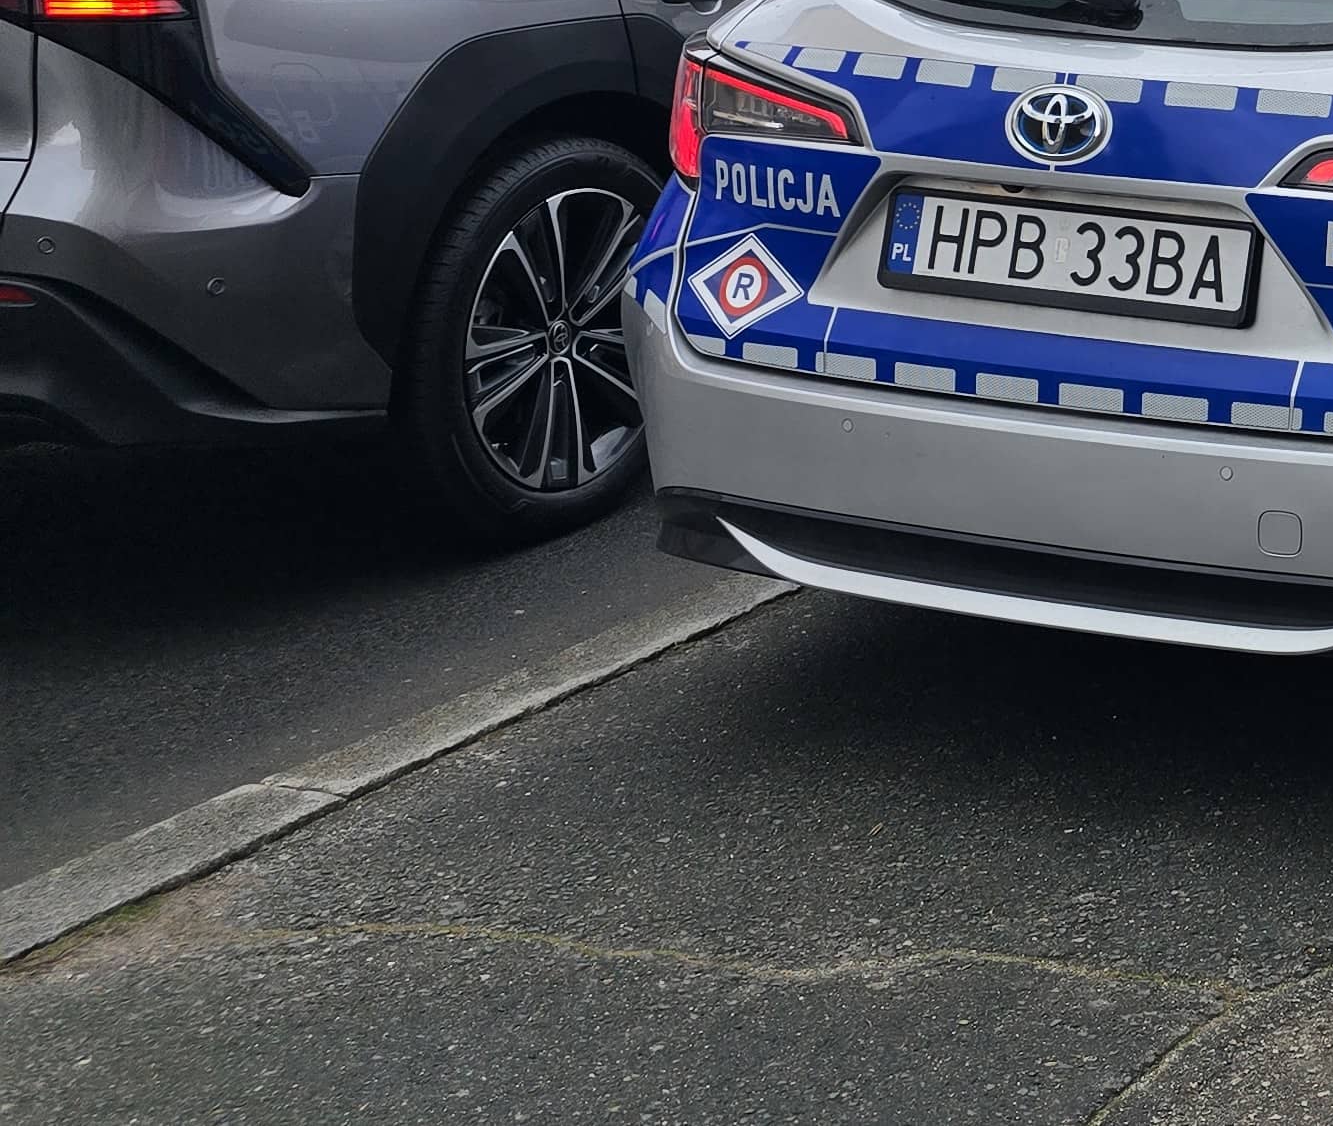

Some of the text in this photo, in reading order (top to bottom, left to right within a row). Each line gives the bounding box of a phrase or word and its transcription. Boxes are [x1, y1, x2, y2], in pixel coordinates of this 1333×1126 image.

[715, 158, 841, 218] POLICJA
[890, 242, 912, 262] PL
[927, 204, 1225, 304] HPB 33BA
[732, 272, 755, 301] R
